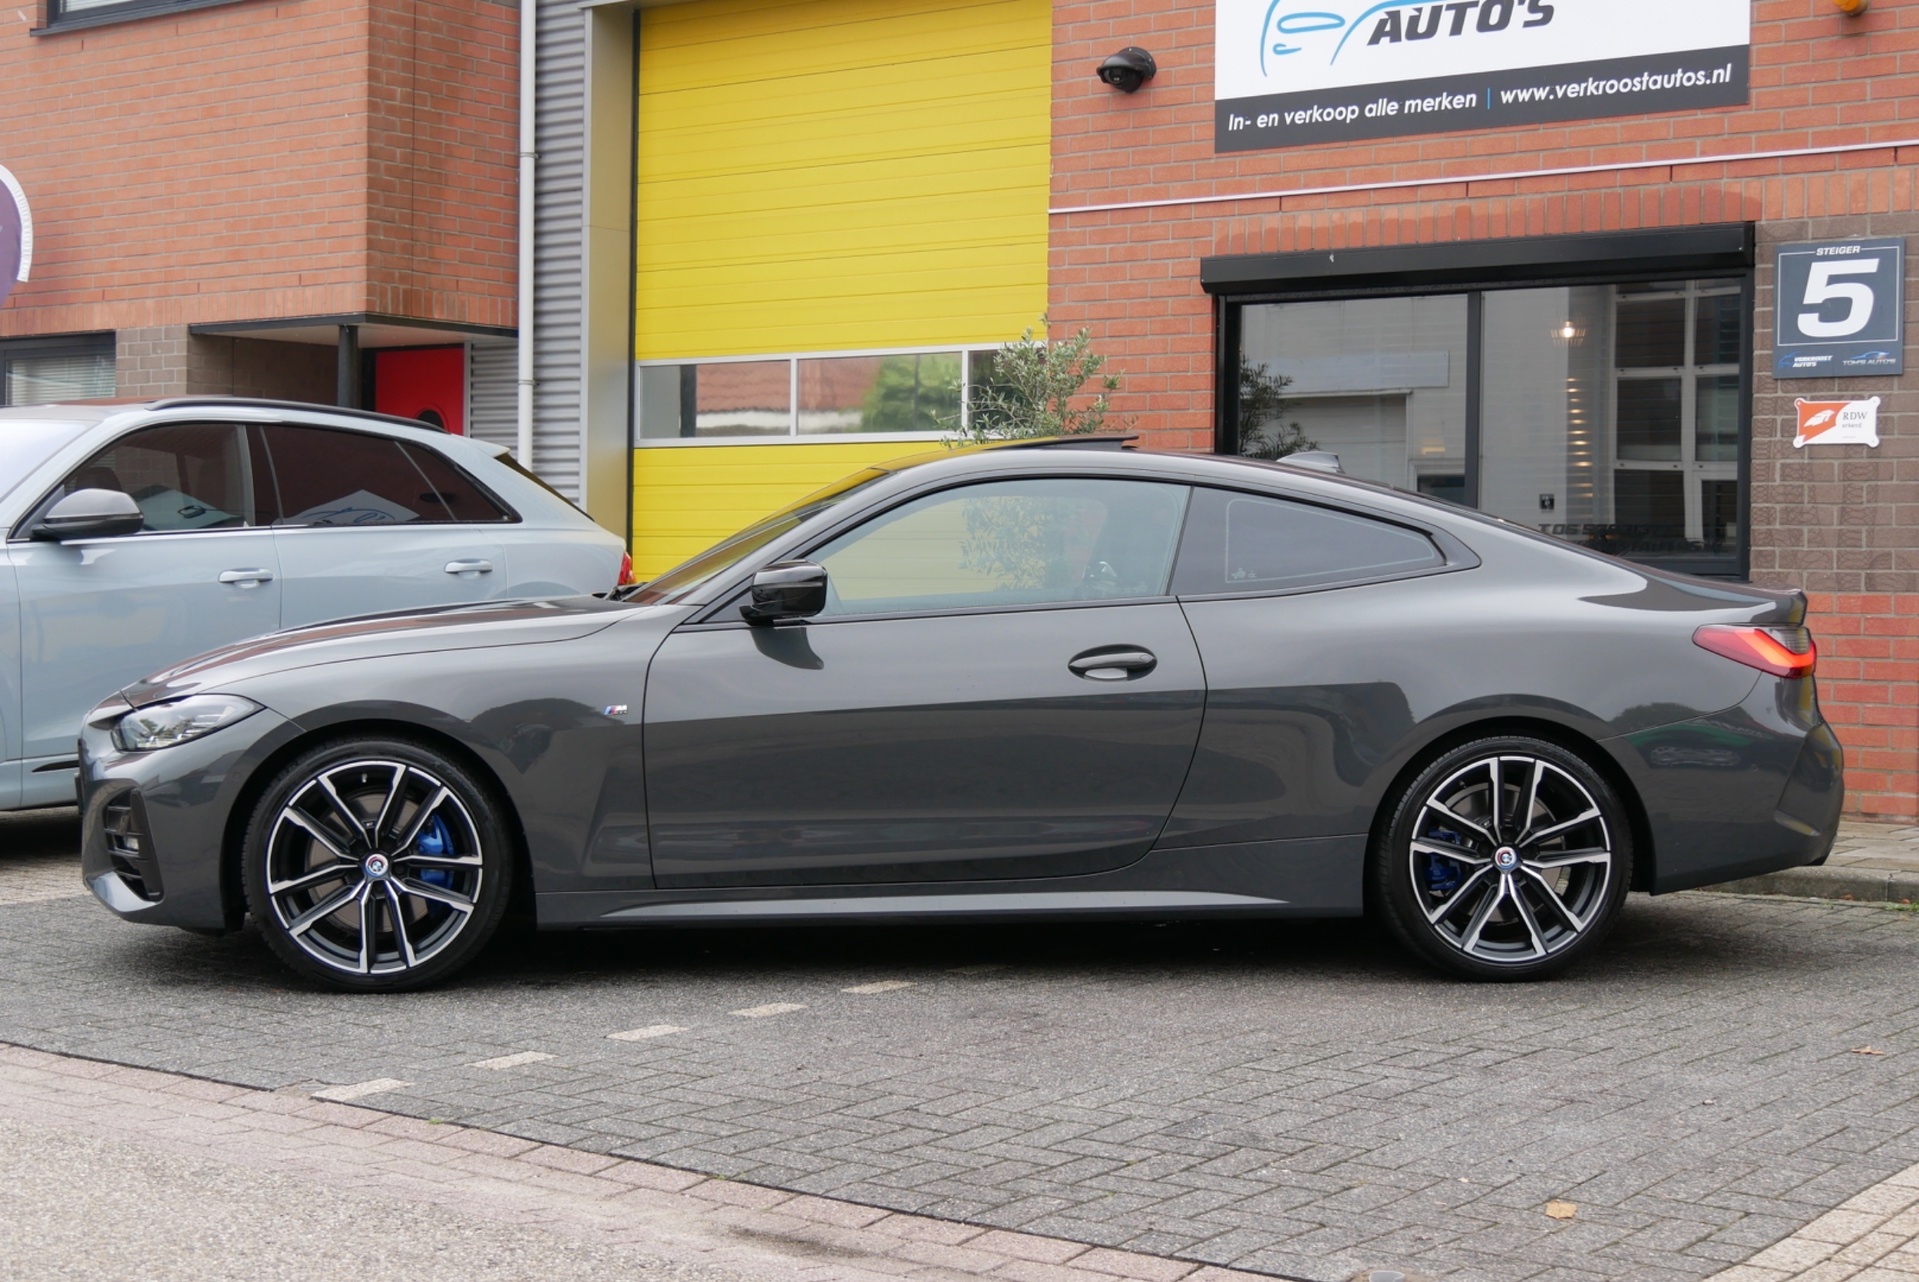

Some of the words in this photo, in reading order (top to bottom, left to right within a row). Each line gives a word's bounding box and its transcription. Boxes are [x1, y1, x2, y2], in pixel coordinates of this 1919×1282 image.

[1228, 113, 1252, 131] In-
[1256, 111, 1279, 128] en
[1284, 103, 1360, 125] verkoop
[1364, 97, 1399, 118] alle
[1403, 92, 1477, 114] merken
[1500, 63, 1732, 104] www.verkroostautos.nl
[1816, 246, 1861, 256] STEIGER
[1797, 258, 1880, 337] 5
[1842, 411, 1868, 421] RDW
